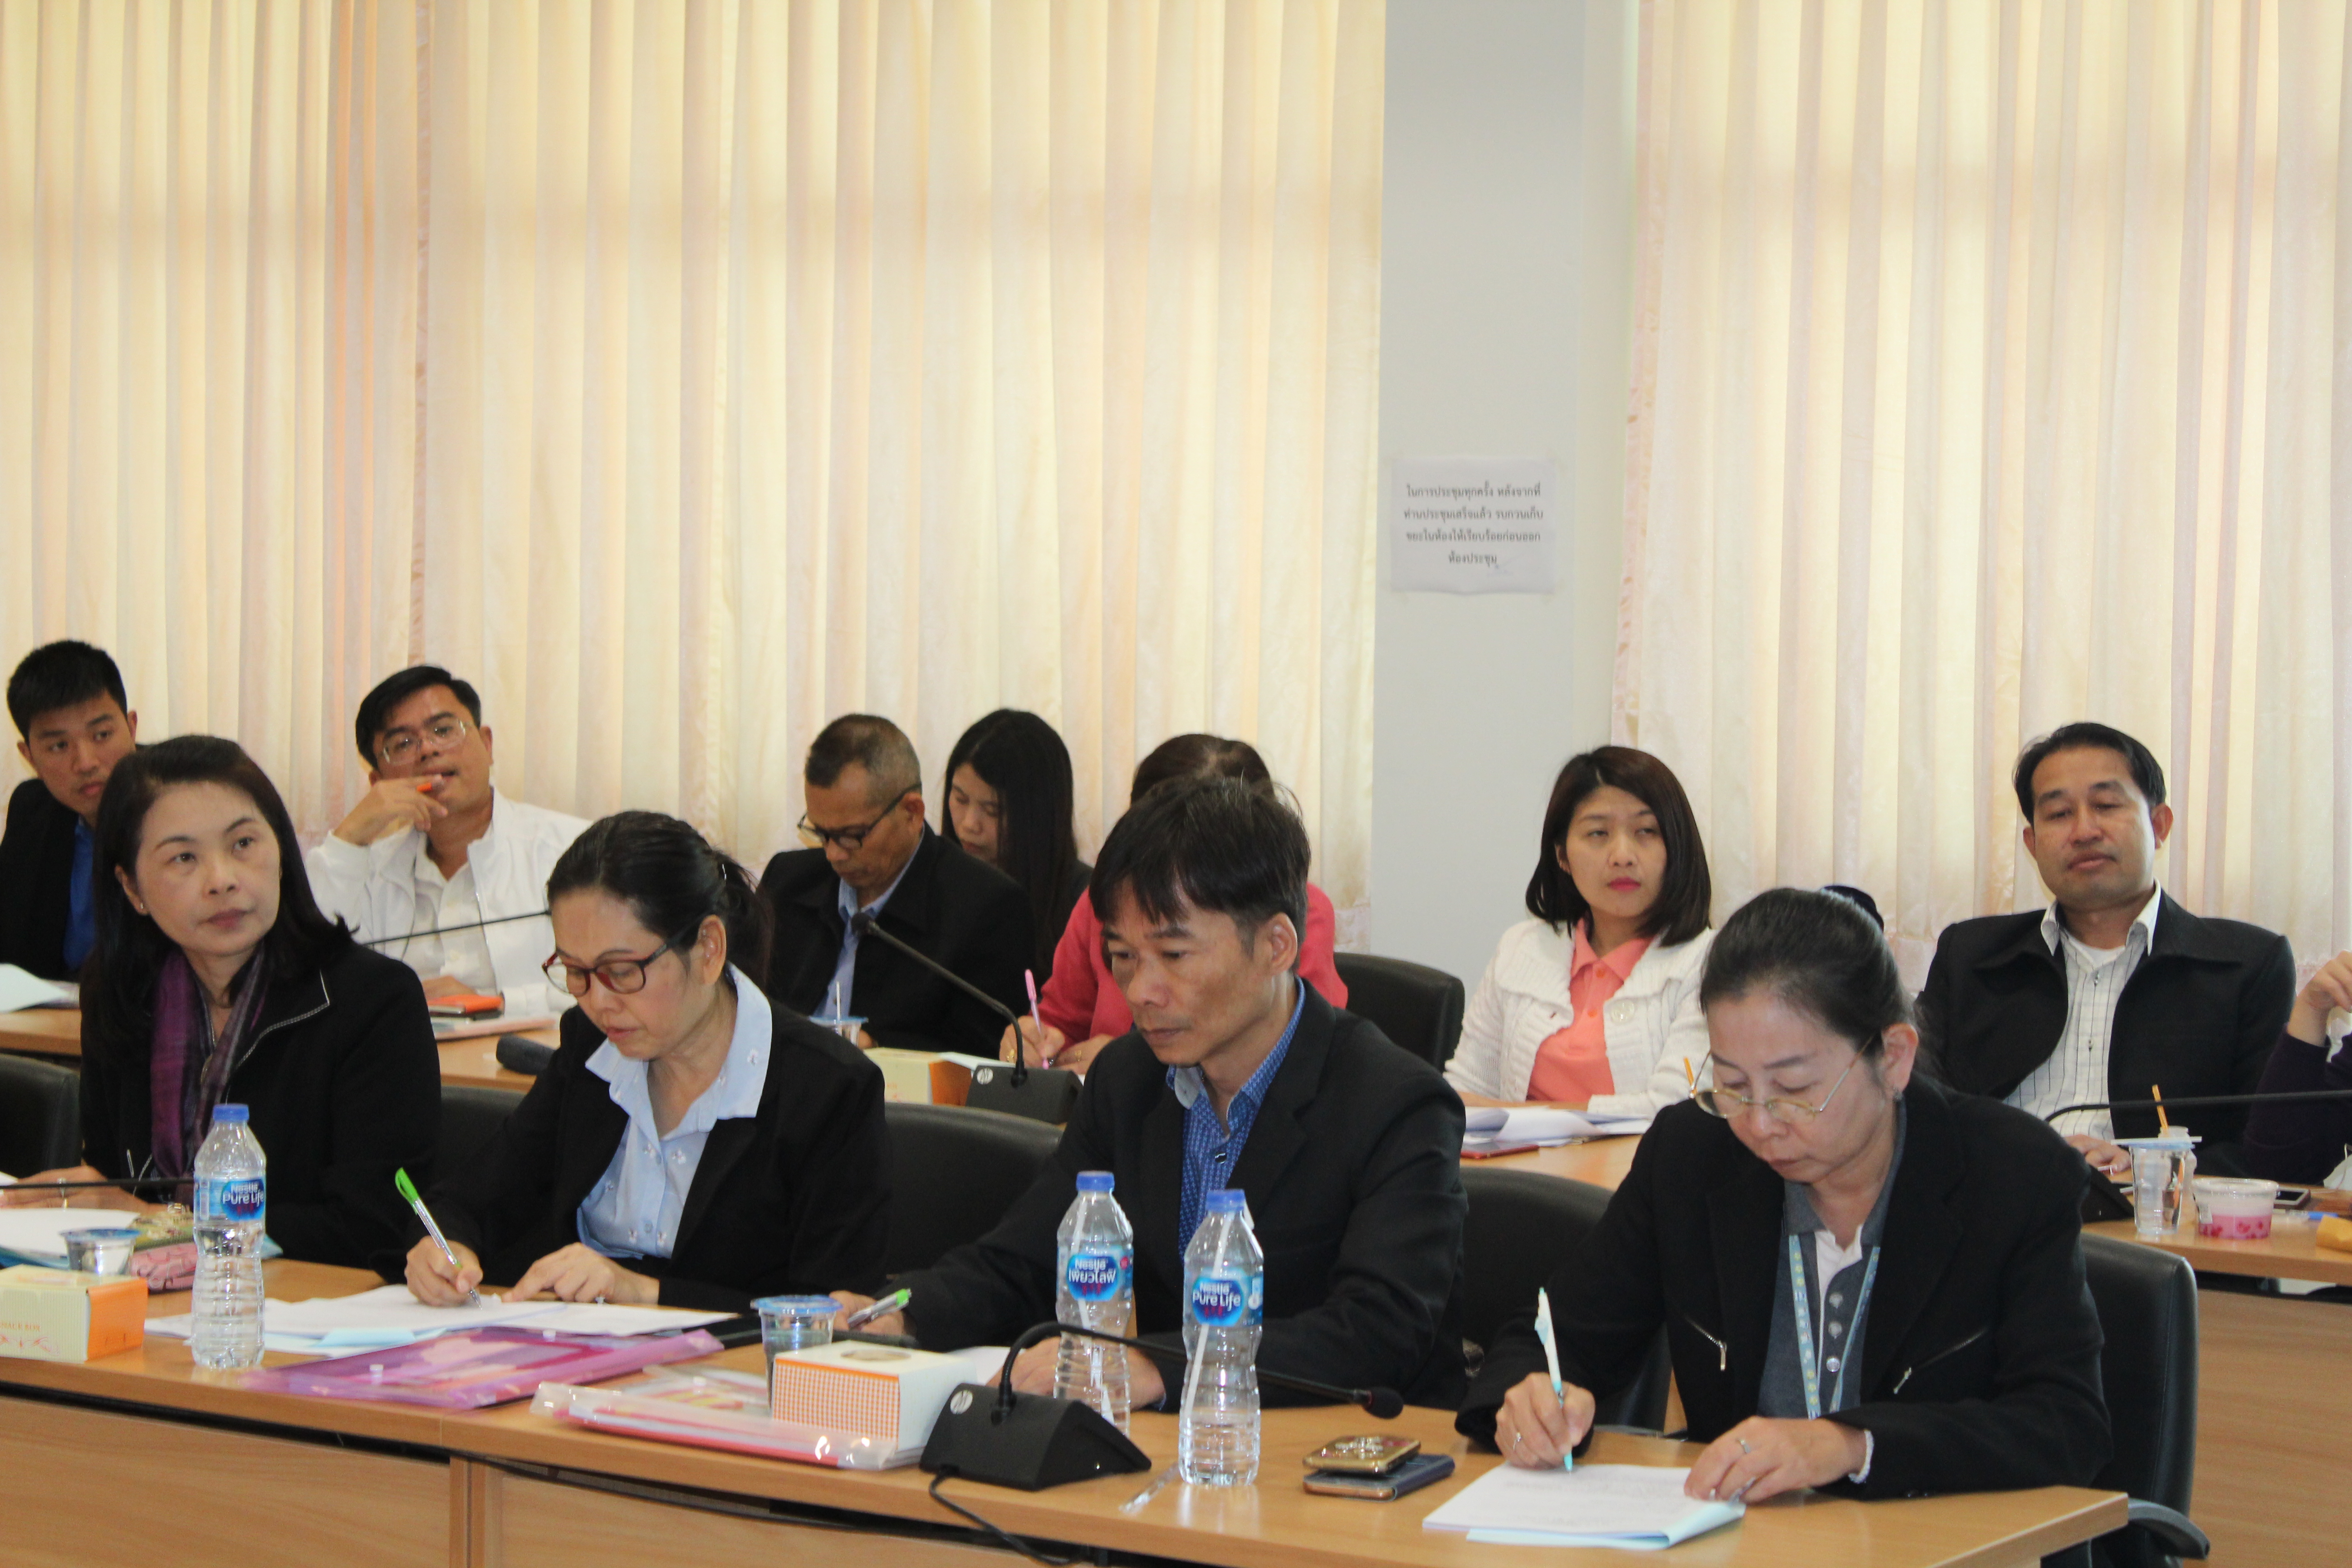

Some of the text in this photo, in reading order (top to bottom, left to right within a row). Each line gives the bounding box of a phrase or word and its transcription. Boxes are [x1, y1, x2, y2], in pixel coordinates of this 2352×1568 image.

[1406, 480, 1541, 501] ในการประชุมทุกครั้ง หลังจากที่
[1404, 506, 1492, 523] ท่านประชุมเสร็จแล้ว
[1449, 549, 1497, 567] ห้องประชุม
[222, 1189, 264, 1207] Pure Life
[1192, 1290, 1241, 1311] Pure Life
